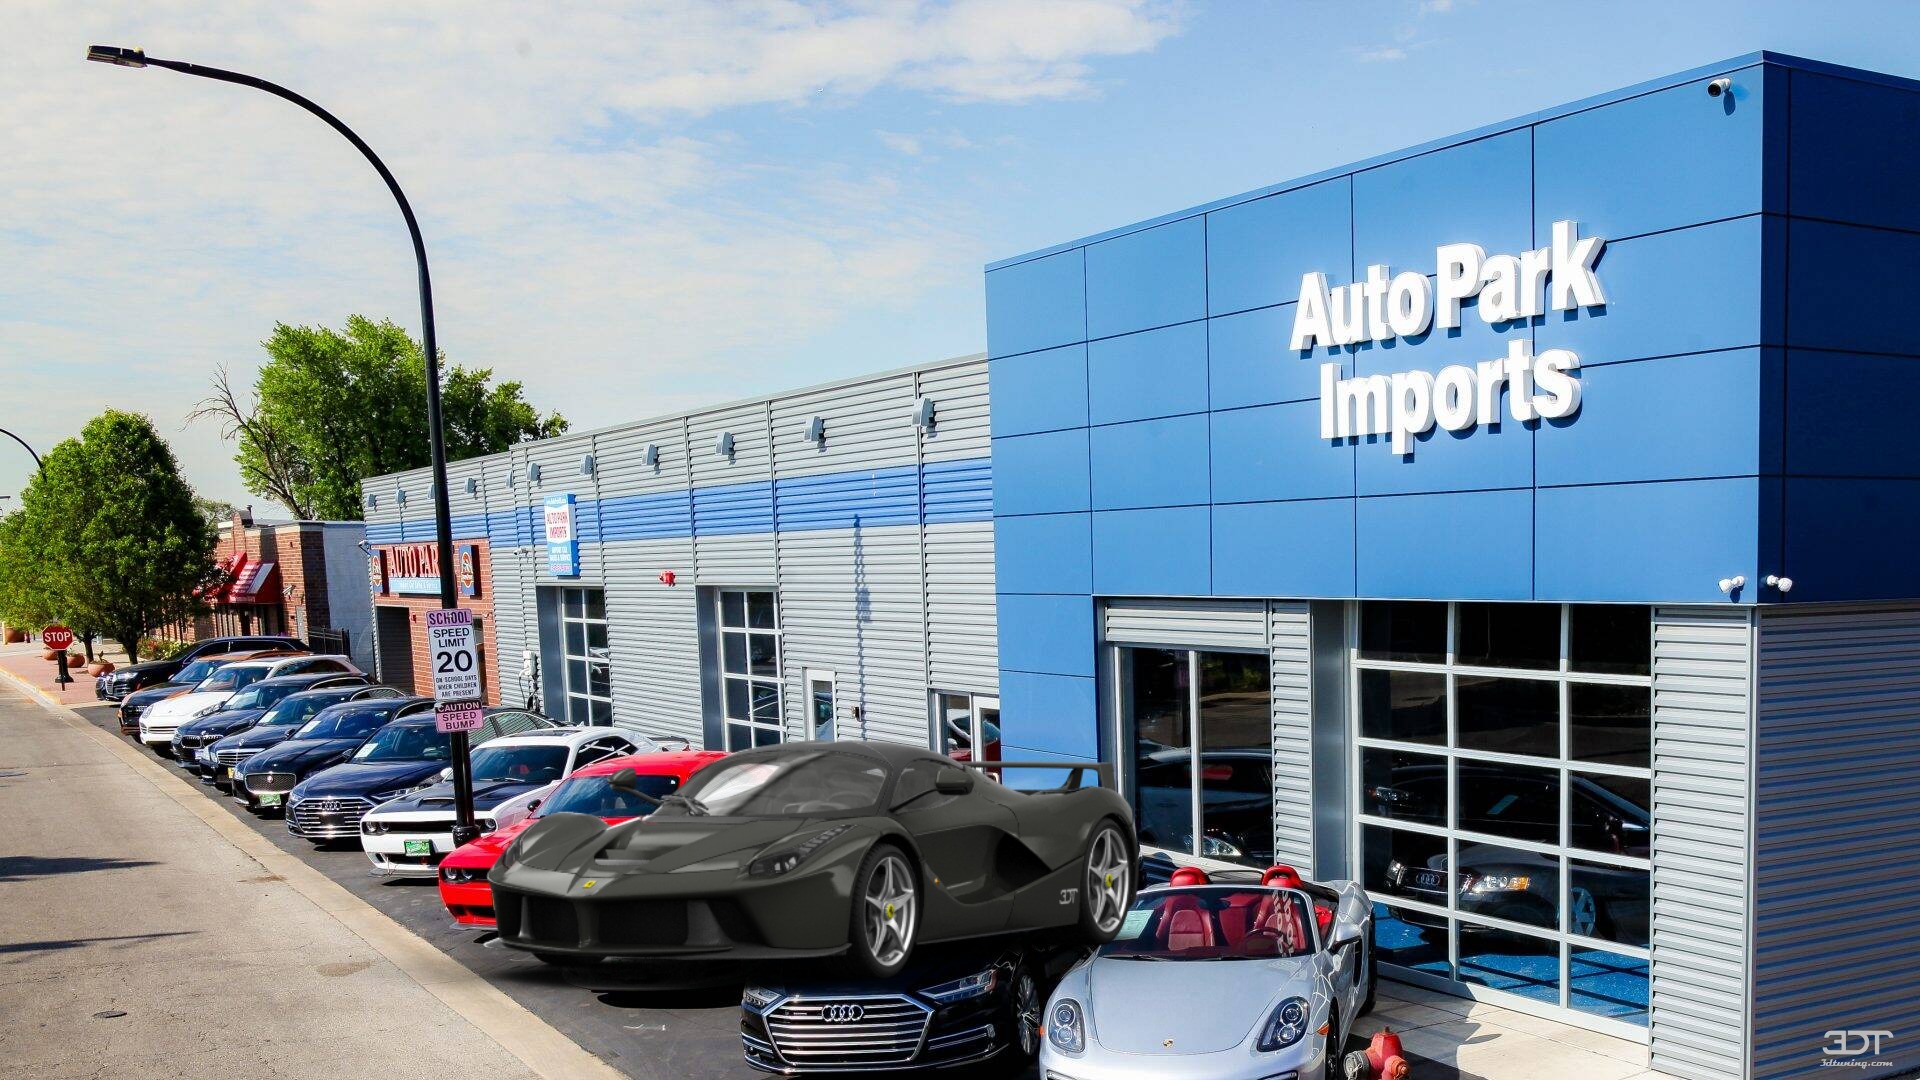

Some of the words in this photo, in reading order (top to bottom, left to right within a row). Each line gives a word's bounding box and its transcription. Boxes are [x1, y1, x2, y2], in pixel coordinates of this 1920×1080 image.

[1320, 338, 1582, 455] Imports
[390, 546, 417, 577] AUTO
[418, 545, 440, 577] PAR
[429, 611, 470, 625] SCHOOL
[44, 631, 70, 642] STOP
[433, 627, 470, 638] SPEED
[438, 637, 466, 648] LIMIT
[436, 650, 472, 673] 20
[445, 675, 464, 683] SCHOOL
[453, 689, 474, 697] PRESENT
[438, 702, 480, 713] CAUTION
[442, 711, 477, 721] SPEED
[445, 720, 475, 730] BUMP
